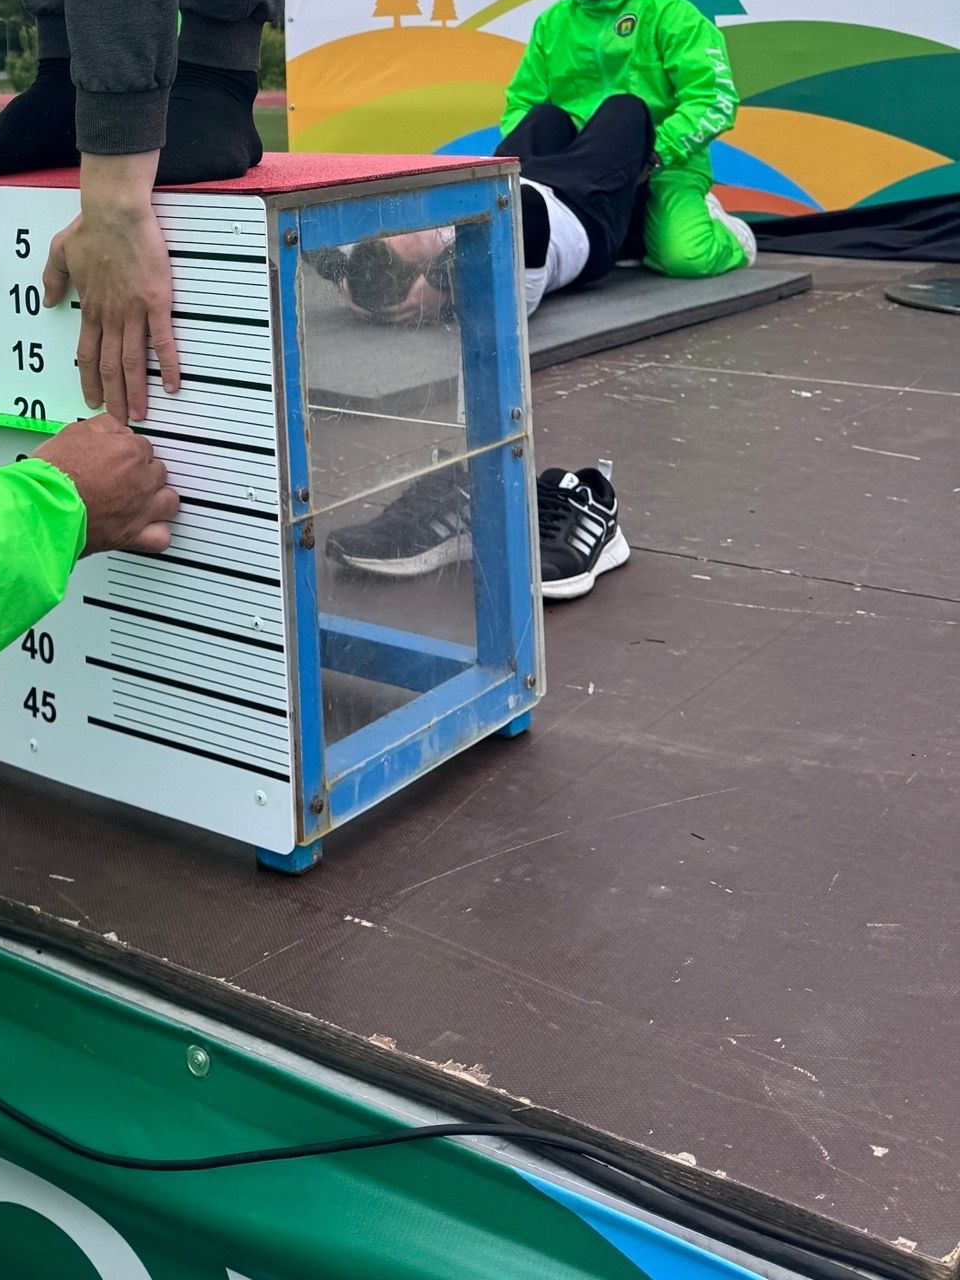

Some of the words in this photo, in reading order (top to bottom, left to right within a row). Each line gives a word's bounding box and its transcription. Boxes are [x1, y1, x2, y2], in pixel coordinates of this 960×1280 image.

[15, 228, 31, 259] 5
[9, 283, 41, 316] 10
[12, 340, 45, 373] 15
[21, 628, 54, 664] 40
[23, 686, 57, 723] 45
